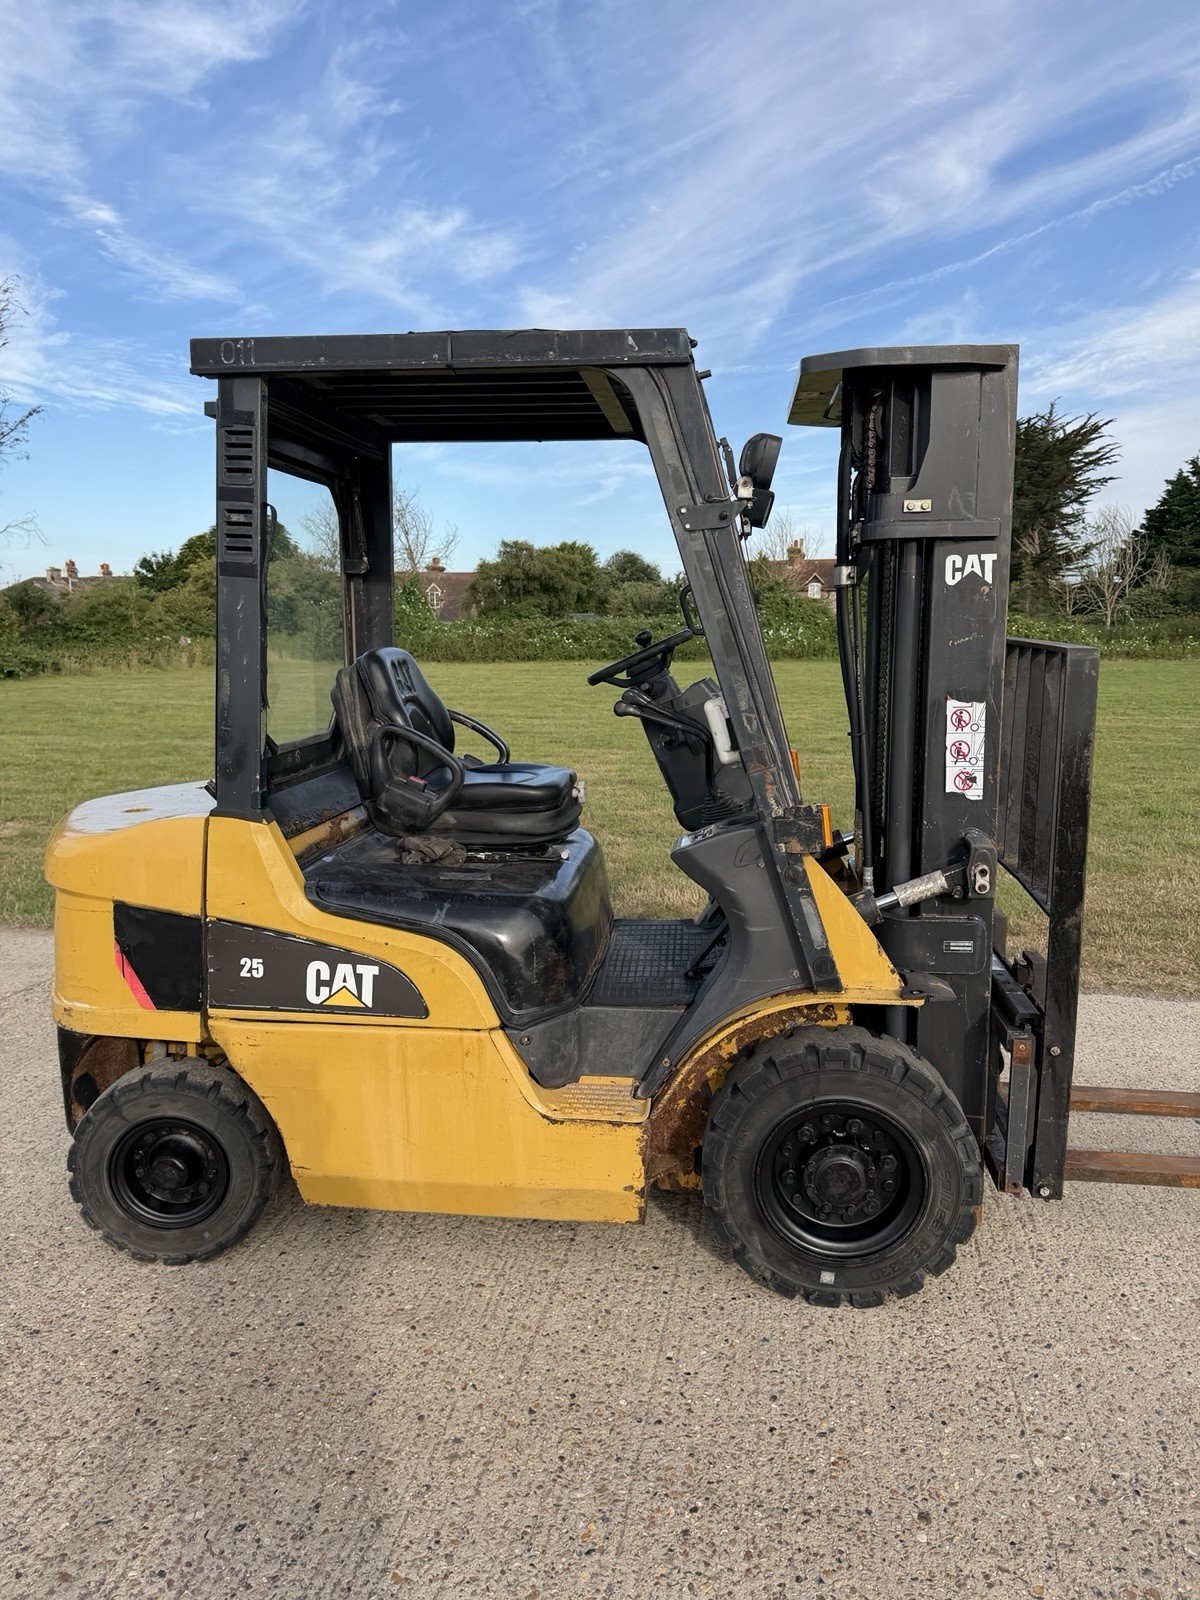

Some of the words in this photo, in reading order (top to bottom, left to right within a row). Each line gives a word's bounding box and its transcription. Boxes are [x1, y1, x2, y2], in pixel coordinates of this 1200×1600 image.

[221, 339, 255, 365] 011
[944, 553, 998, 586] CAT
[239, 957, 264, 979] 25
[305, 960, 380, 1009] CAT
